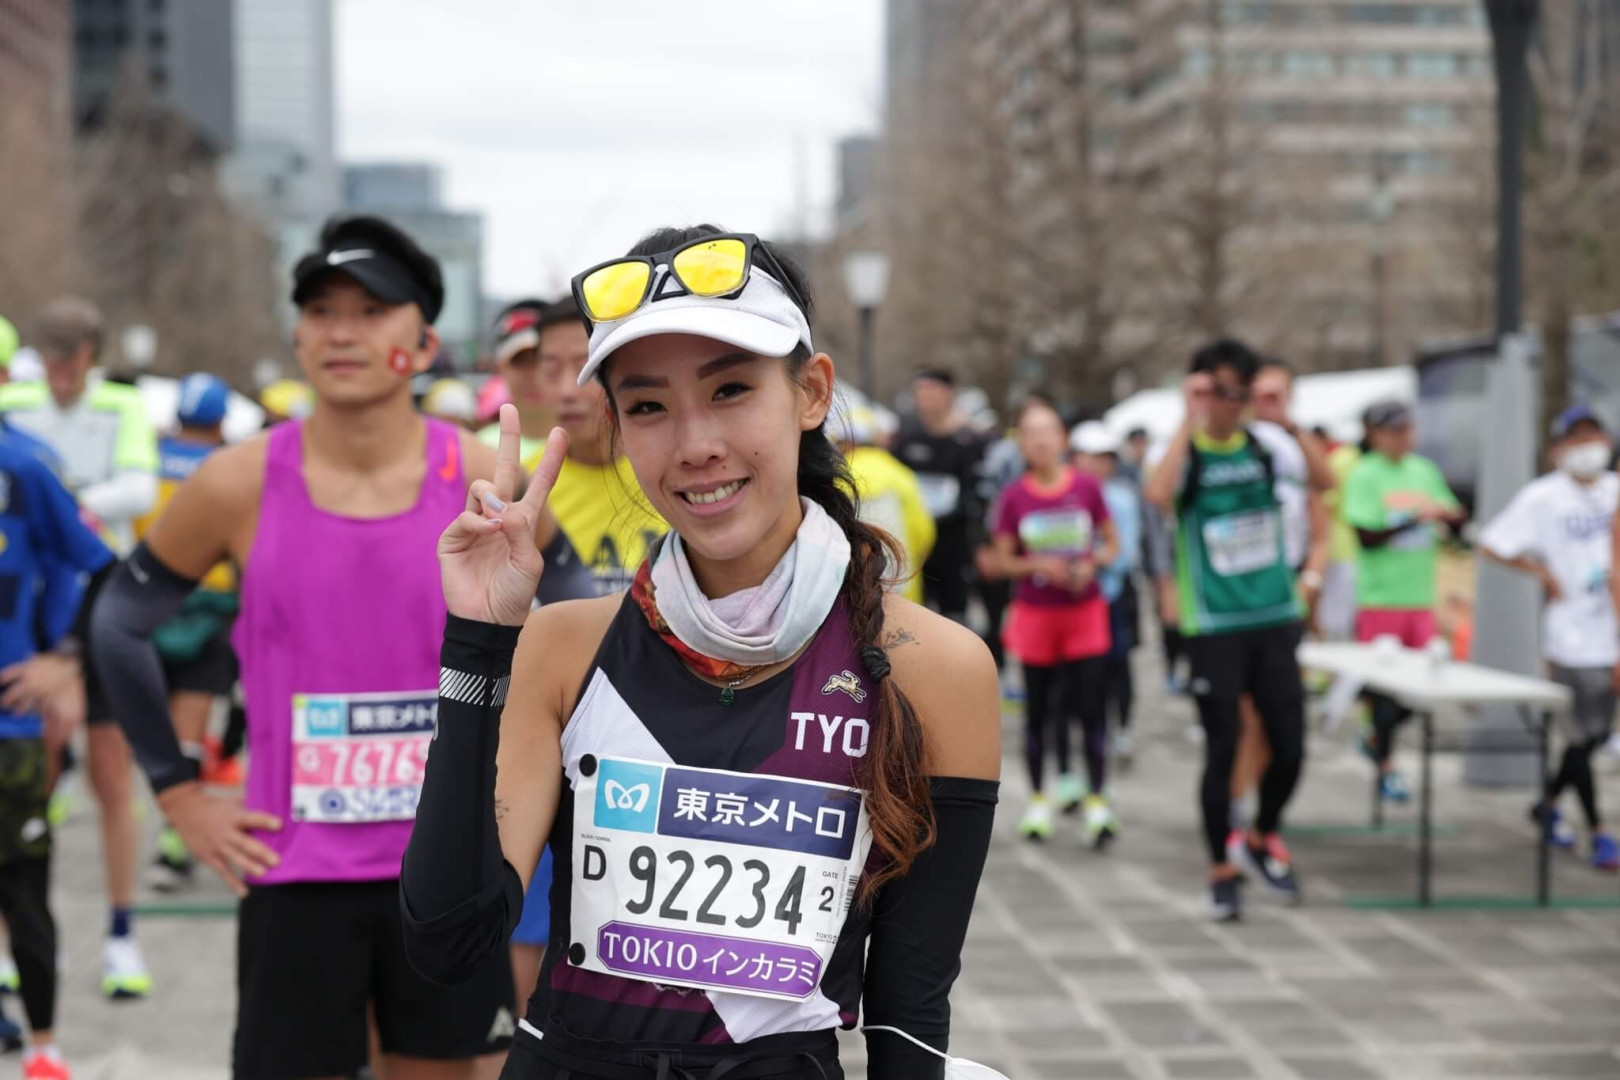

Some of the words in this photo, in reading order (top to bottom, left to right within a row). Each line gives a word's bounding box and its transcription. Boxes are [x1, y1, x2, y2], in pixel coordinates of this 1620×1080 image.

[791, 712, 870, 758] TYO
[673, 787, 846, 839] 東京メトロ
[583, 844, 607, 881] D
[625, 845, 806, 936] 92234
[818, 885, 834, 912] 2
[822, 870, 839, 880] GATE
[603, 931, 698, 972] TOKIO
[703, 948, 816, 986] インカラミ
